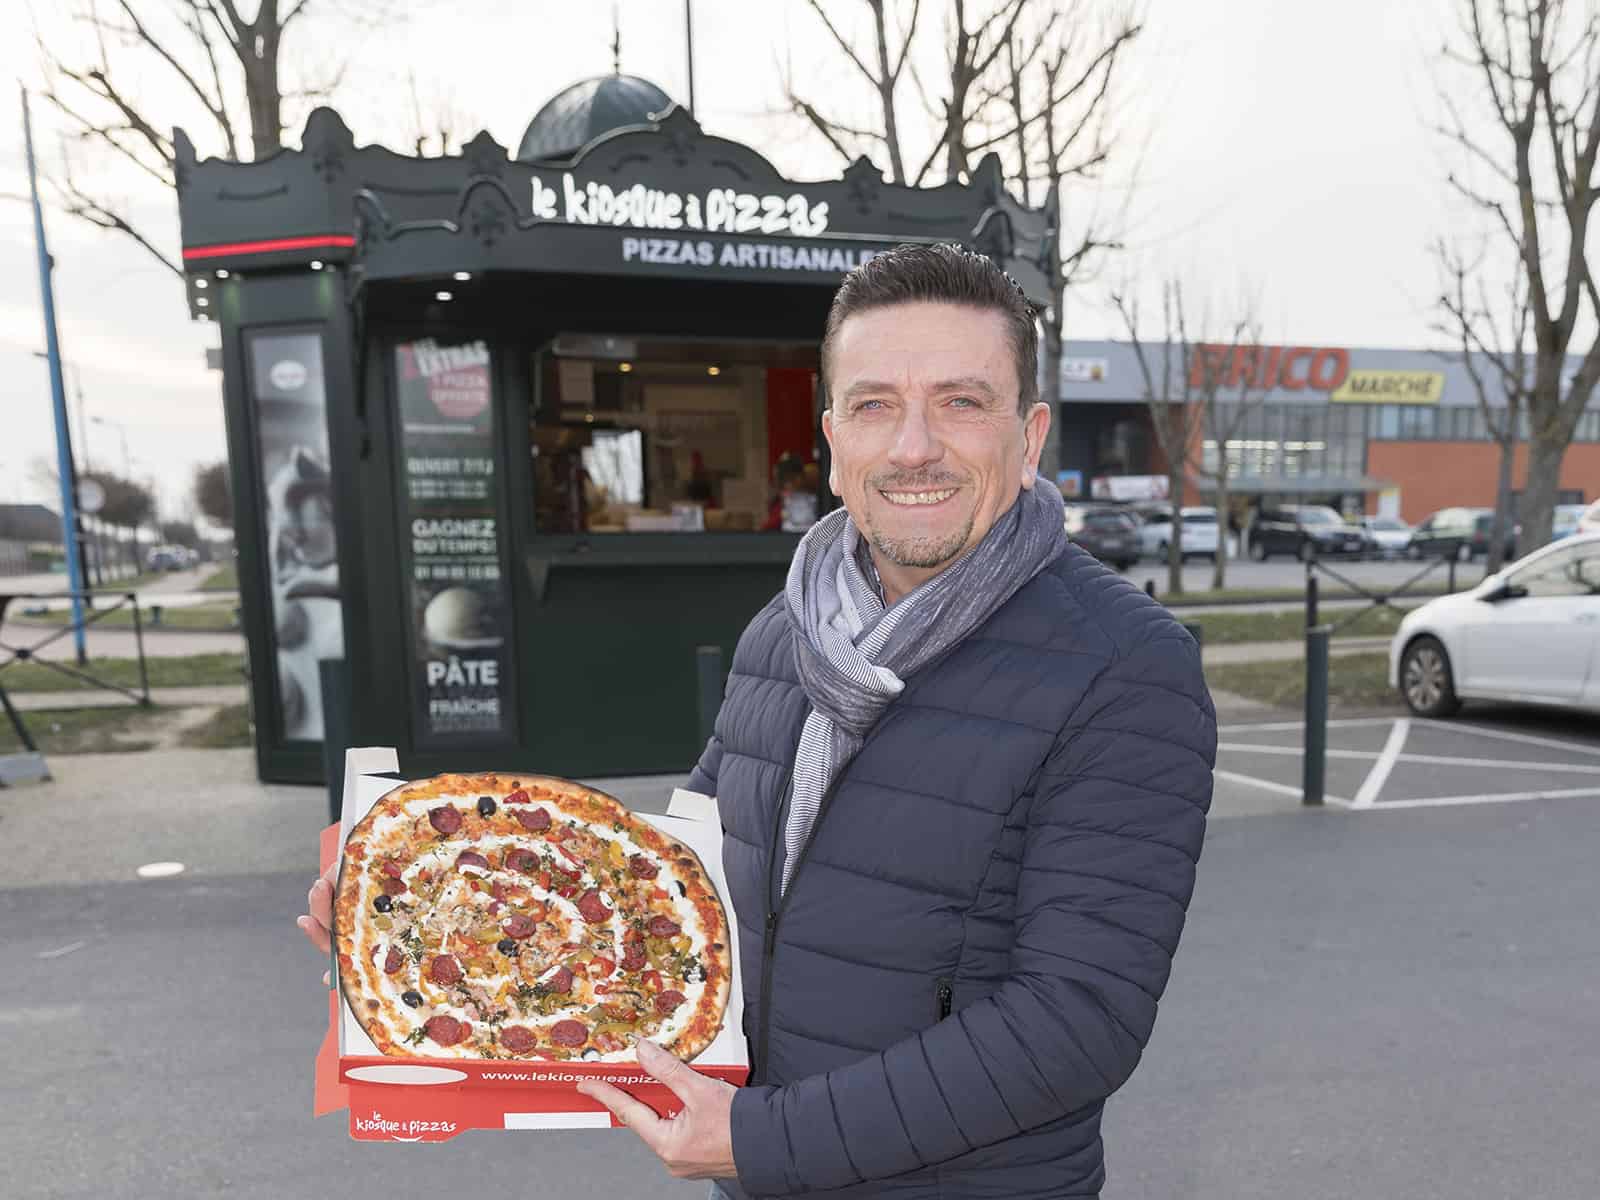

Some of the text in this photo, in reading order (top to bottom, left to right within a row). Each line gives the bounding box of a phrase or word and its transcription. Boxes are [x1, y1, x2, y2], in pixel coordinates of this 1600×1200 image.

[531, 176, 557, 219] le
[563, 172, 683, 229] kiosque
[706, 188, 829, 237] pizzas
[622, 237, 875, 273] PIZZAS ARTISANALE
[1350, 372, 1434, 396] MARCHÉ
[411, 518, 497, 538] GAGNEZ
[427, 654, 499, 687] PÂTE
[429, 696, 500, 715] FRAÎCHE
[356, 1117, 400, 1133] kiosque
[409, 1120, 457, 1136] pizzas
